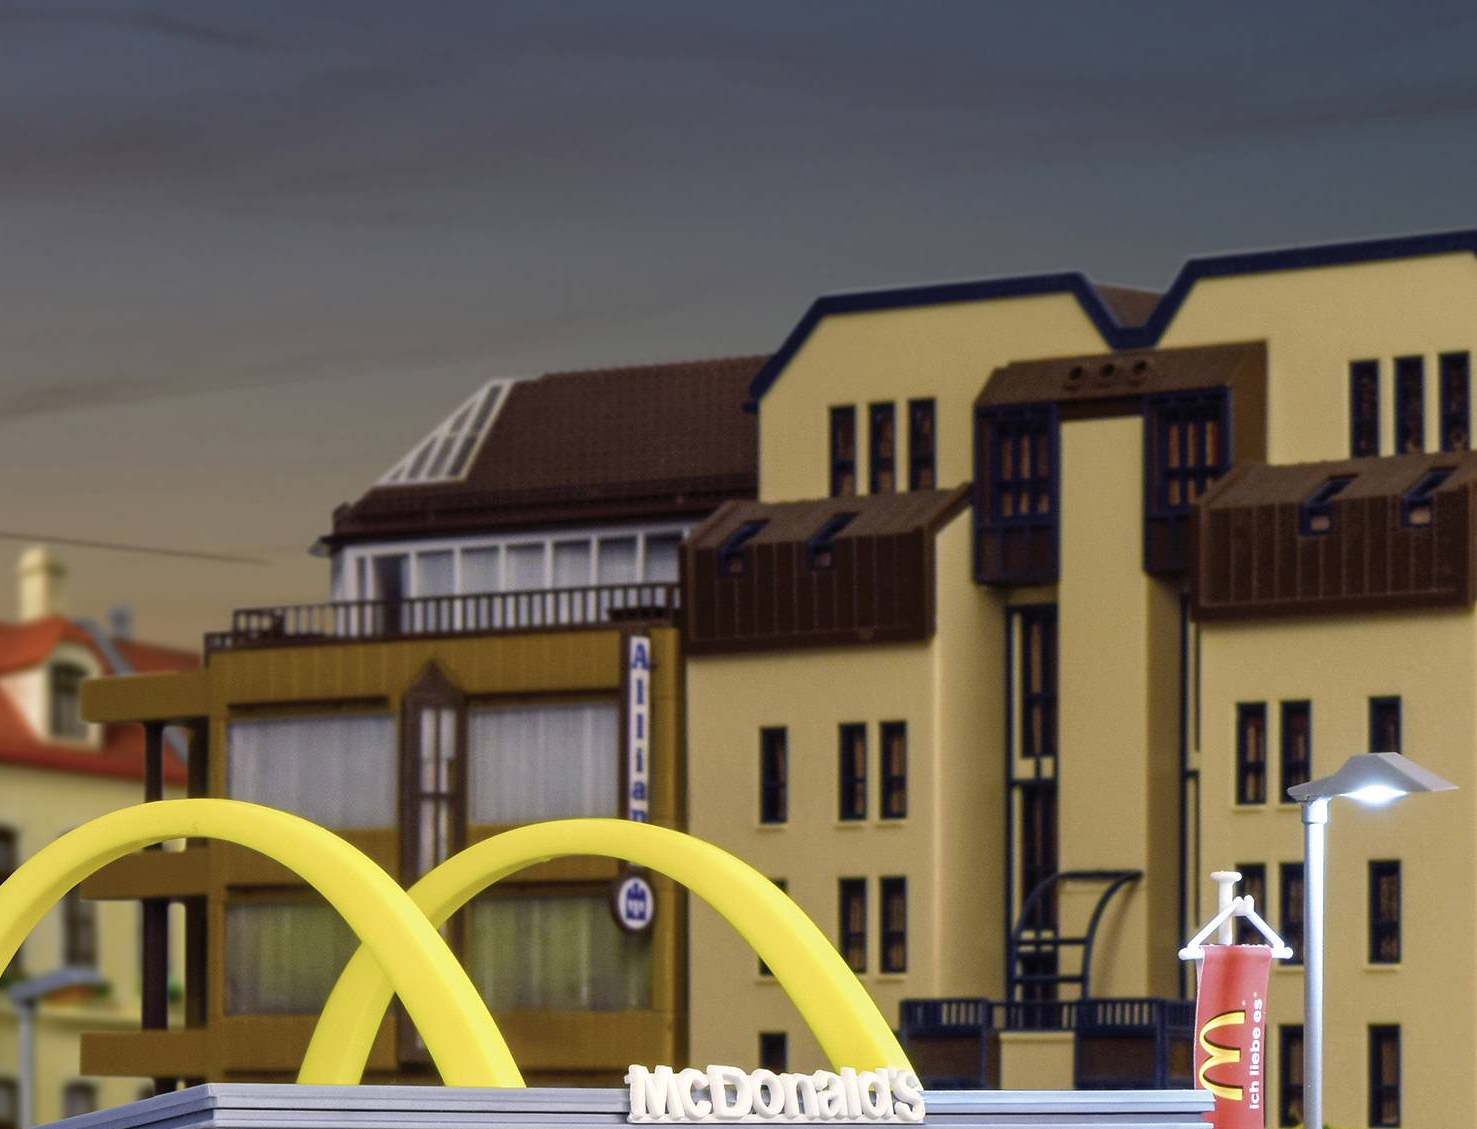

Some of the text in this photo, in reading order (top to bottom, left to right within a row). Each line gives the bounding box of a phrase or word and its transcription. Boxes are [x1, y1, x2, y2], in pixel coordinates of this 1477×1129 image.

[629, 643, 650, 823] Allian
[628, 1064, 925, 1121] McDonald's
[1249, 998, 1263, 1110] ich liebe es
